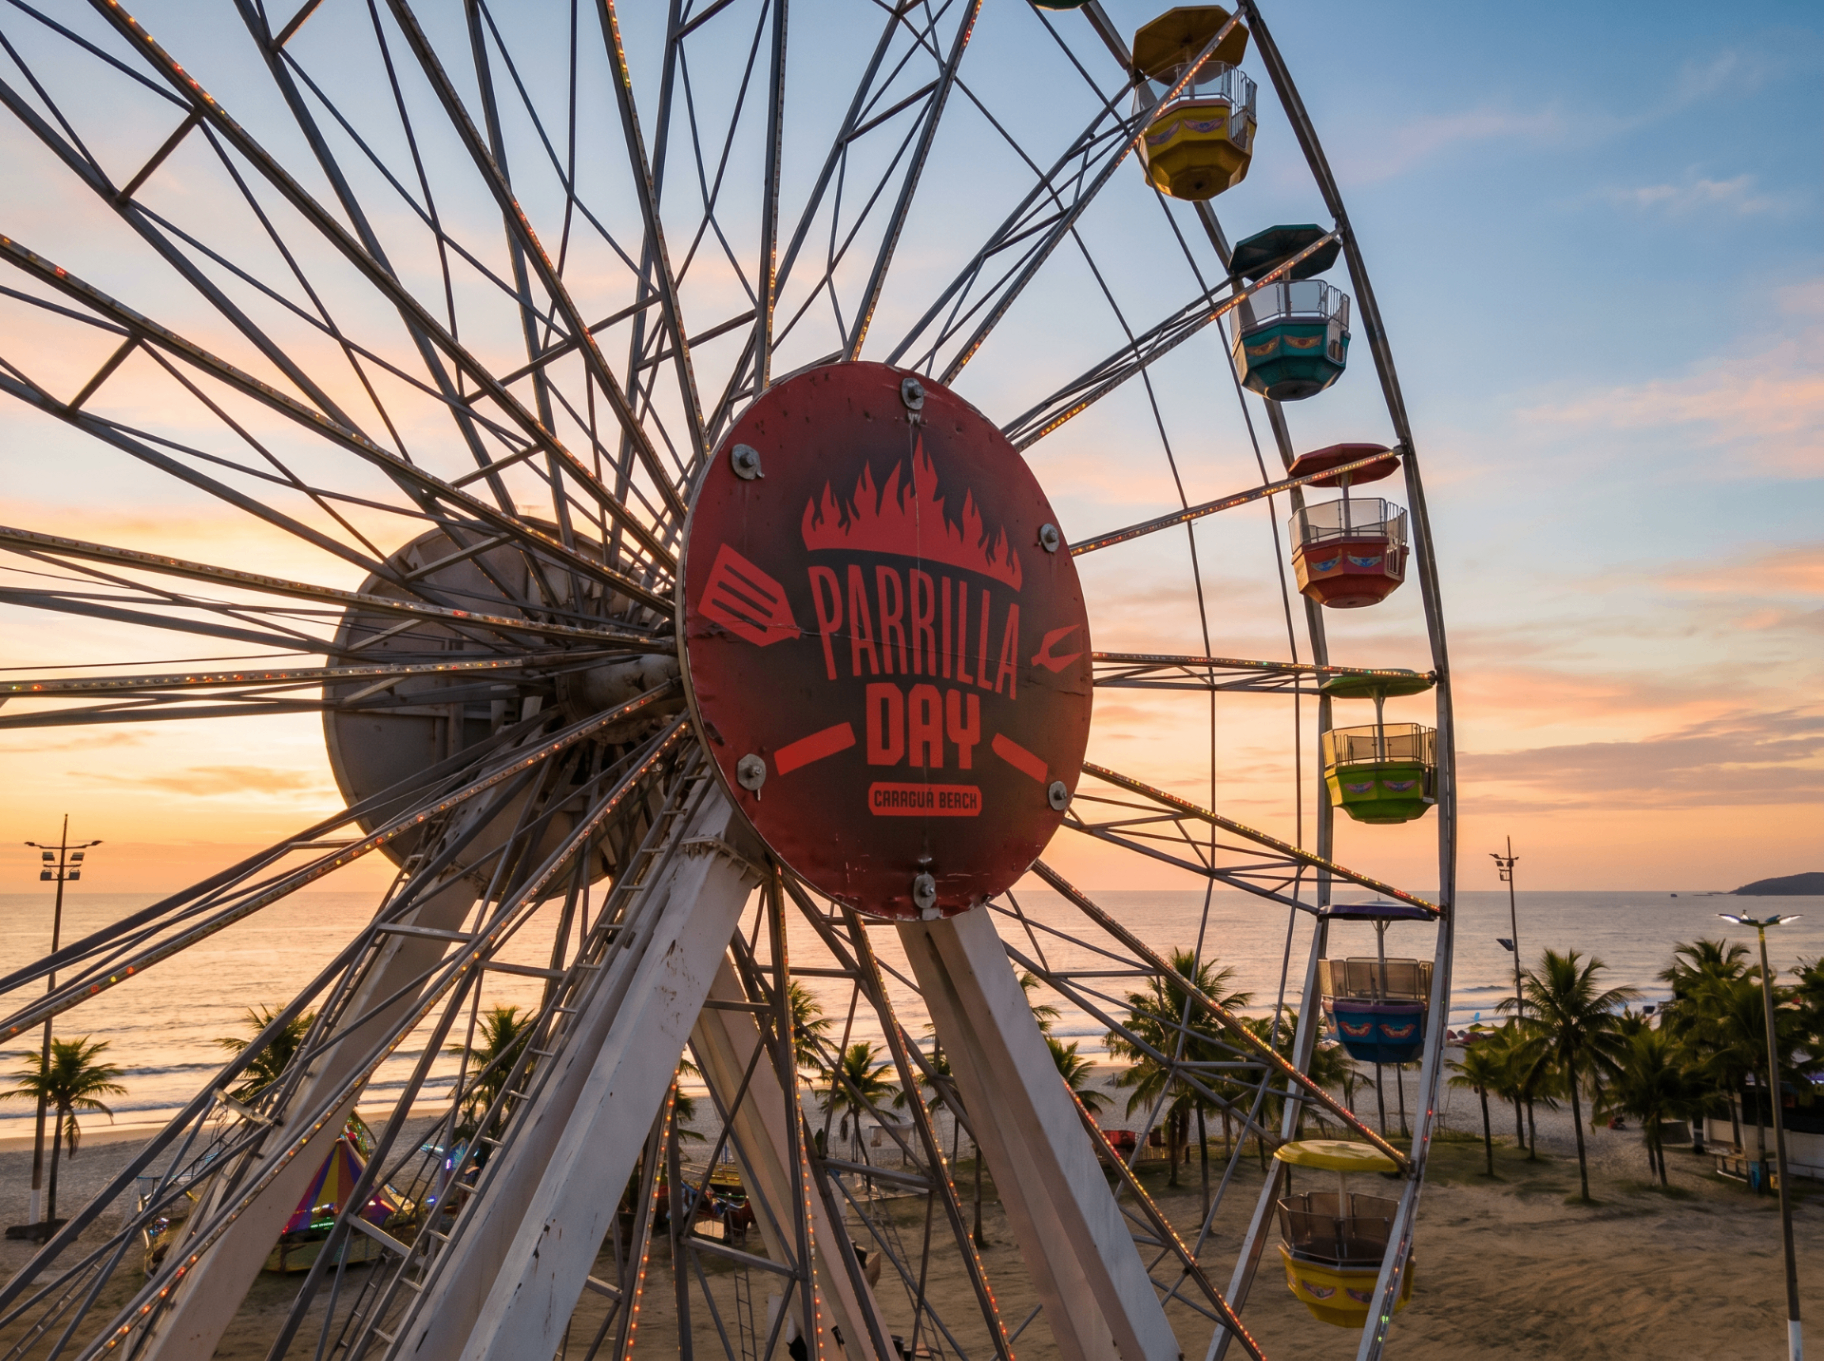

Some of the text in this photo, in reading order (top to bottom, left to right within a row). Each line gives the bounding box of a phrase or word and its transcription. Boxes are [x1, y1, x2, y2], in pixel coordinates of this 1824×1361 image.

[808, 564, 1020, 700] PARRILLA
[866, 682, 980, 769] DAY
[874, 787, 978, 809] CARAGUÁ BEACH
